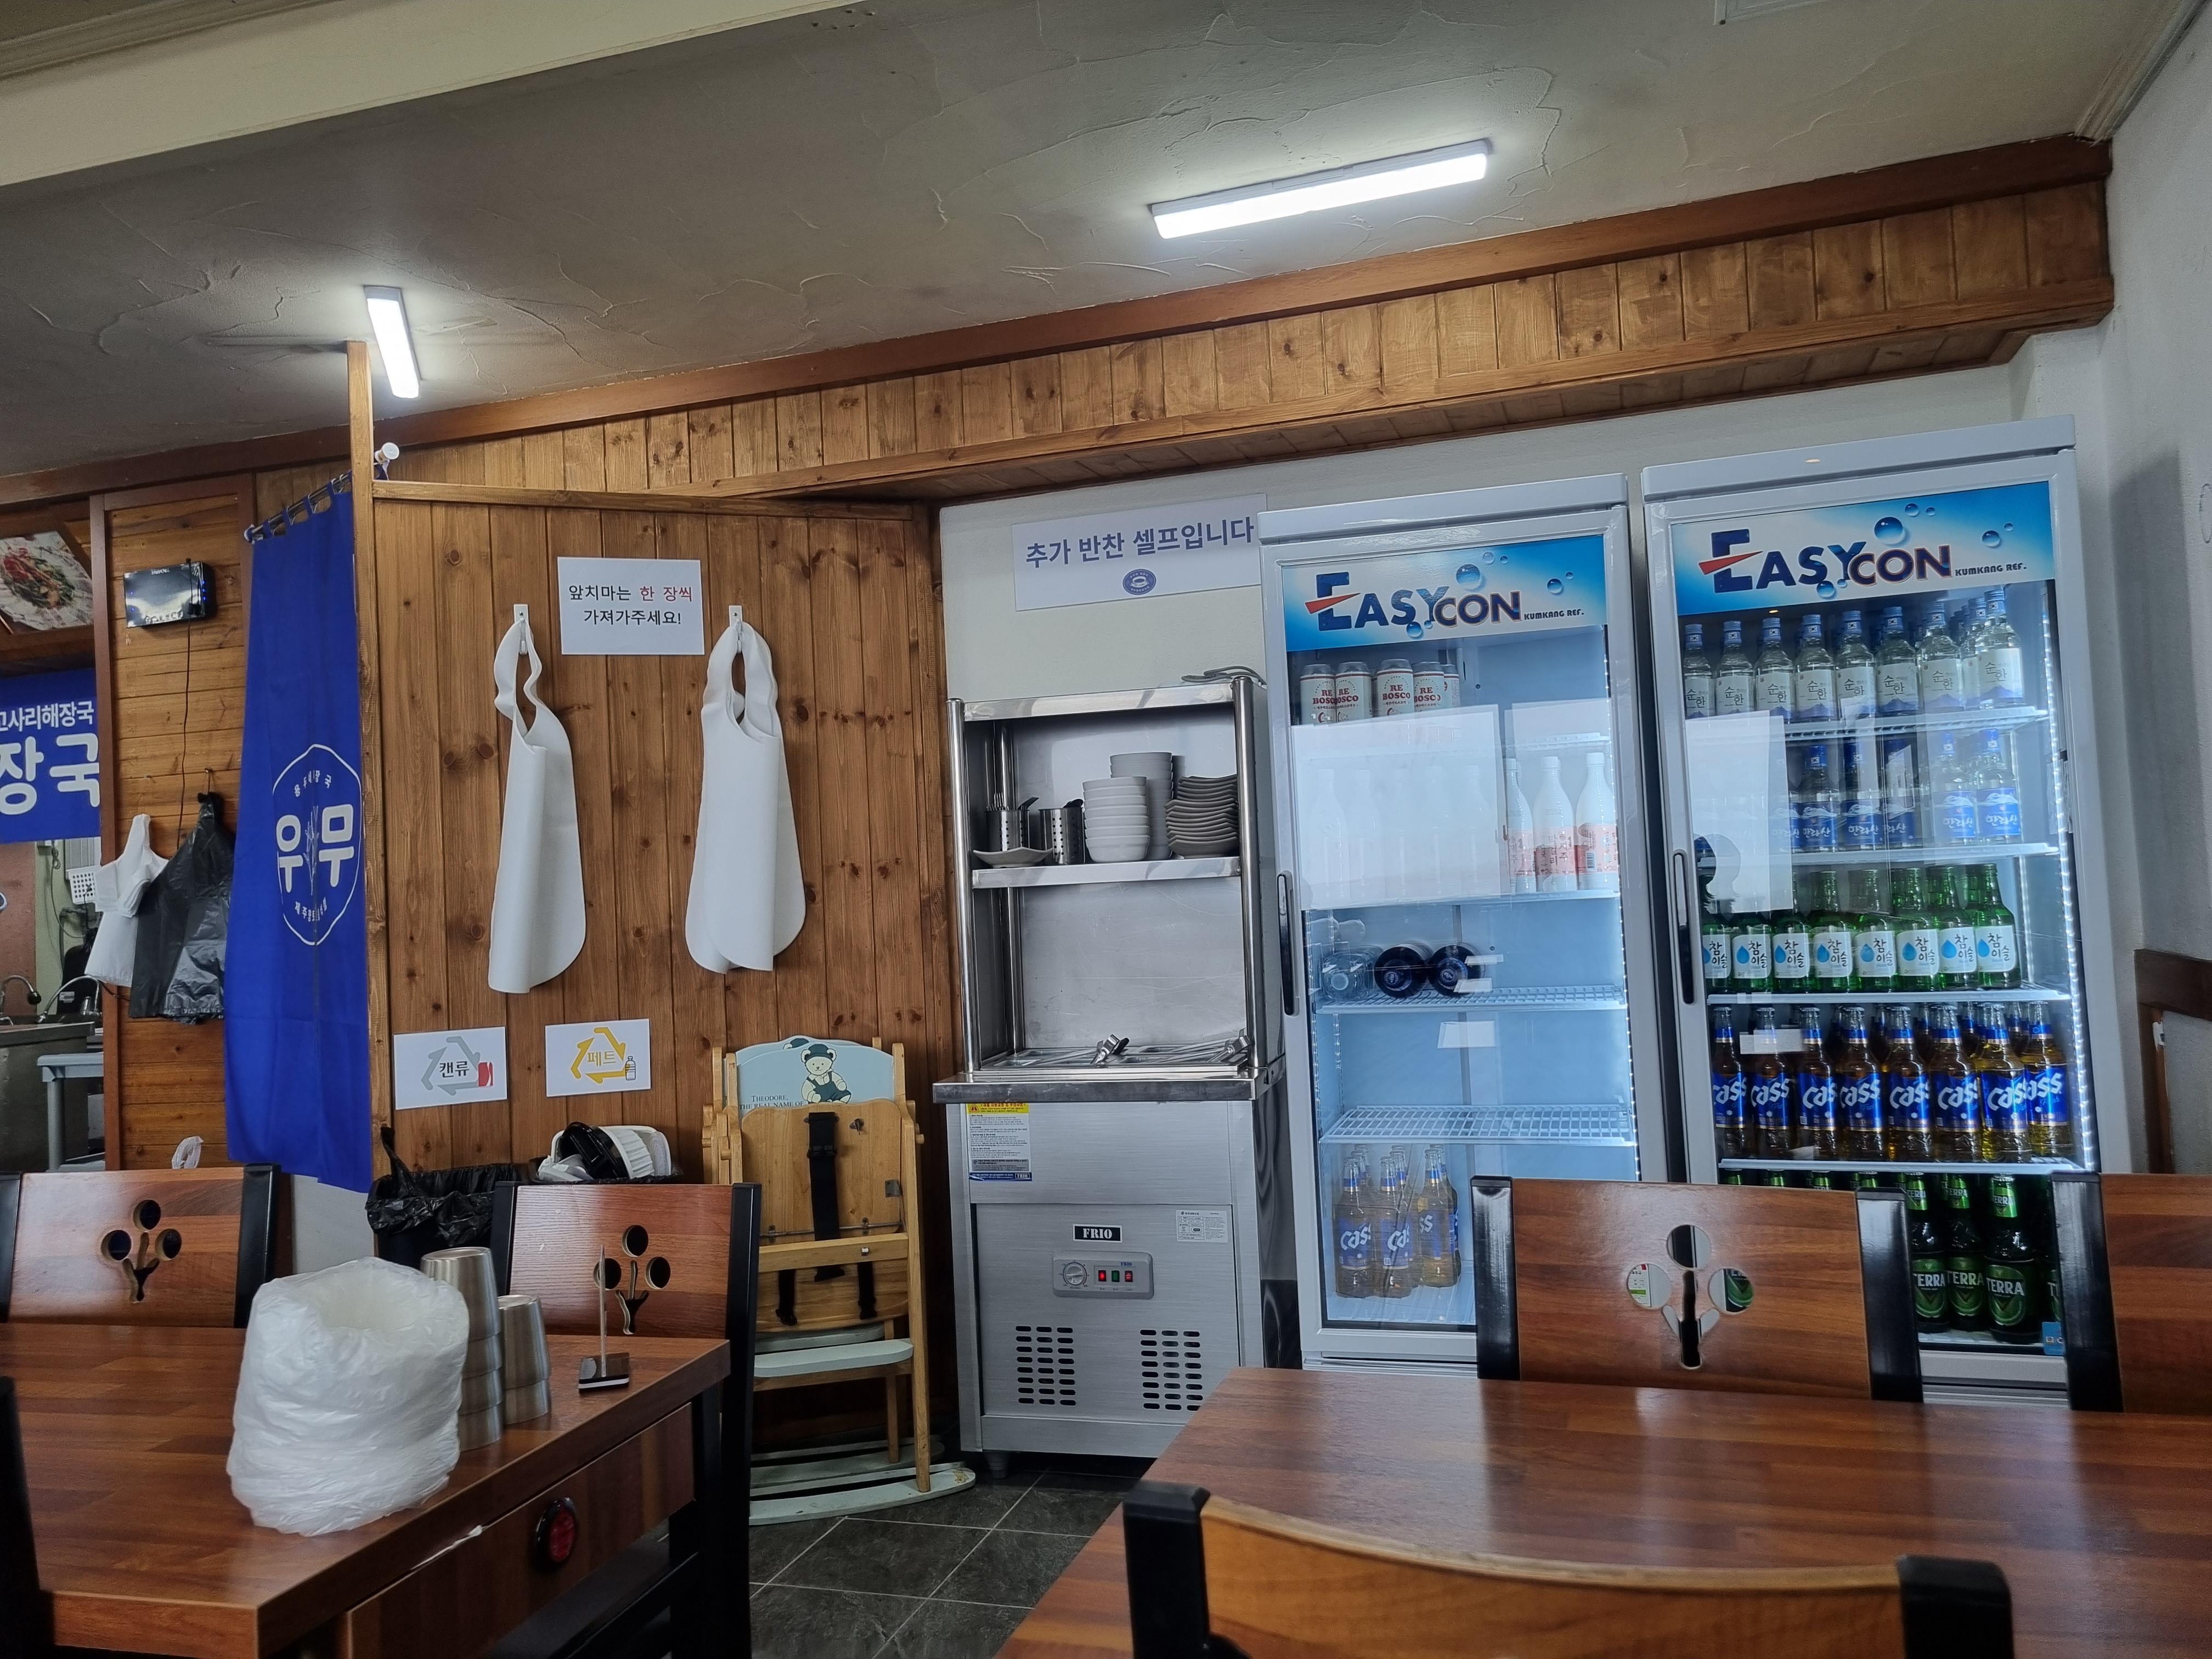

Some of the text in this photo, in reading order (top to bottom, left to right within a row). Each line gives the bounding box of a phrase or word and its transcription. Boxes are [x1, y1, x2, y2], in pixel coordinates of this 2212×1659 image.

[1026, 517, 1254, 568] 추가 반찬 셀프입니다
[1955, 565, 2003, 576] KUMKANG
[569, 585, 692, 602] 앞치마는 한 장씩
[584, 610, 681, 625] 가져가주세요!
[1524, 611, 1564, 620] KUMKANG
[1943, 817, 1973, 828] 한라산
[1986, 814, 2018, 826] 한라산
[1848, 824, 1879, 836] 한라산
[586, 1051, 617, 1066] 페트
[439, 1060, 470, 1078] 캔류
[1083, 1228, 1112, 1239] FRIO
[1987, 1277, 2024, 1296] TERRA
